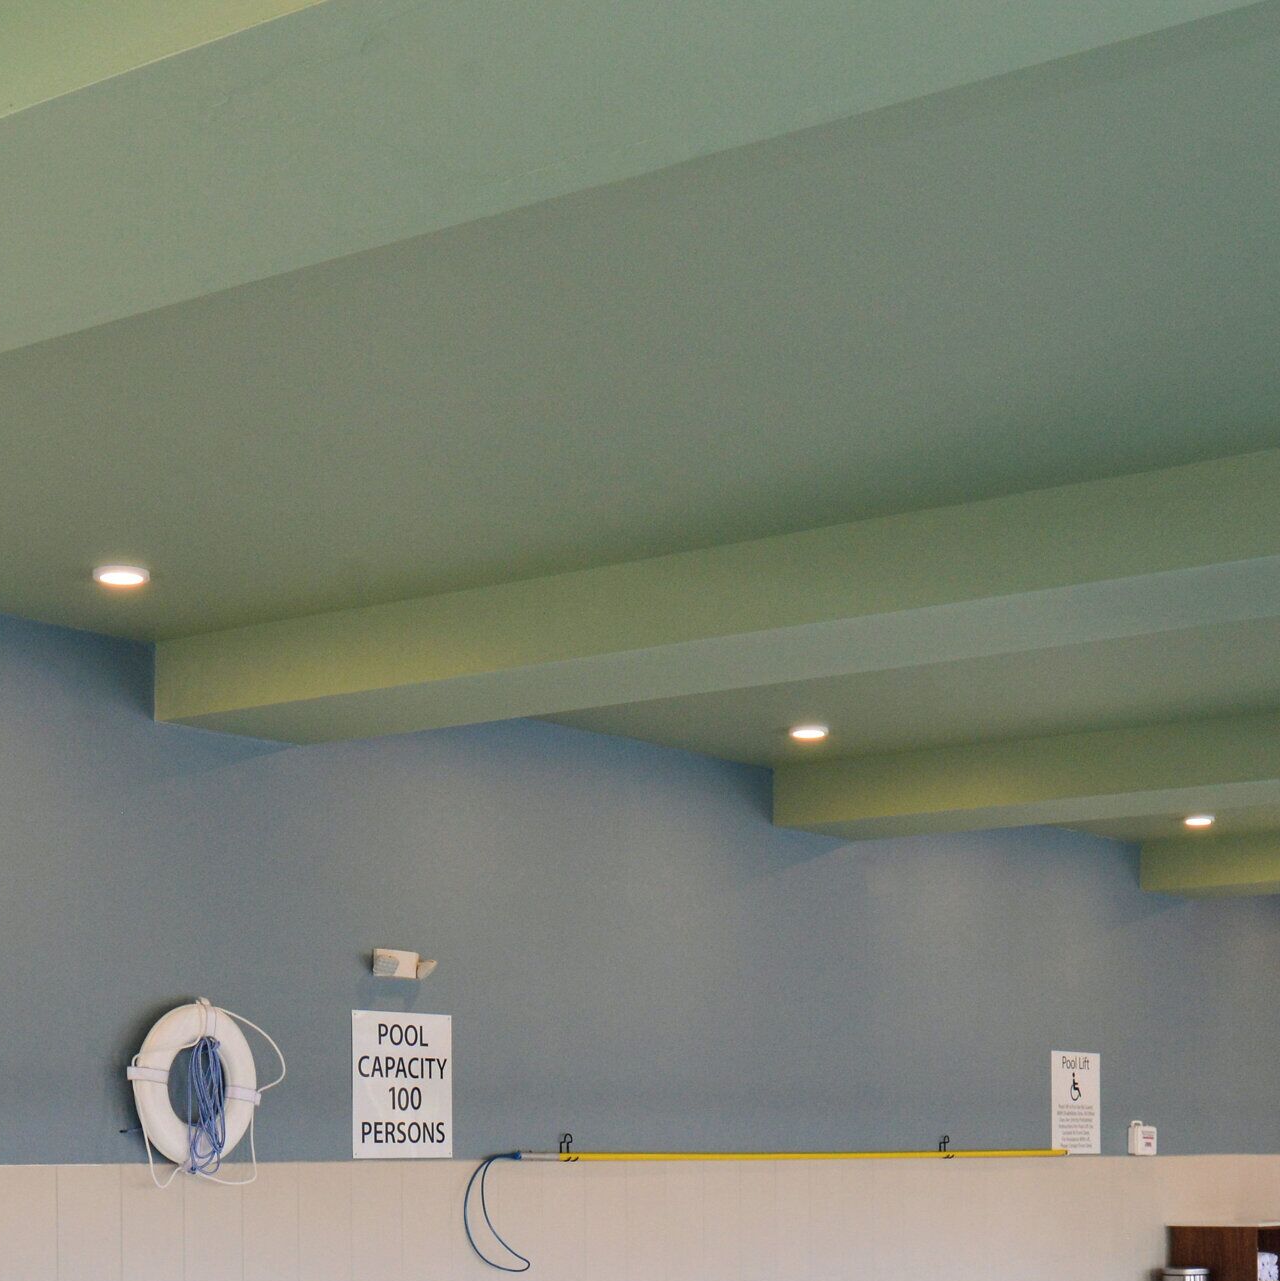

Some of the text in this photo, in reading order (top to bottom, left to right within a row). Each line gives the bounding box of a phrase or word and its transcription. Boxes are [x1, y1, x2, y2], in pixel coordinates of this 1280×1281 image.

[378, 1023, 428, 1047] POOL
[358, 1055, 447, 1079] CAPACITY
[1062, 1056, 1090, 1070] Pool Lift
[388, 1087, 422, 1111] 100
[361, 1121, 446, 1144] PERSONS
